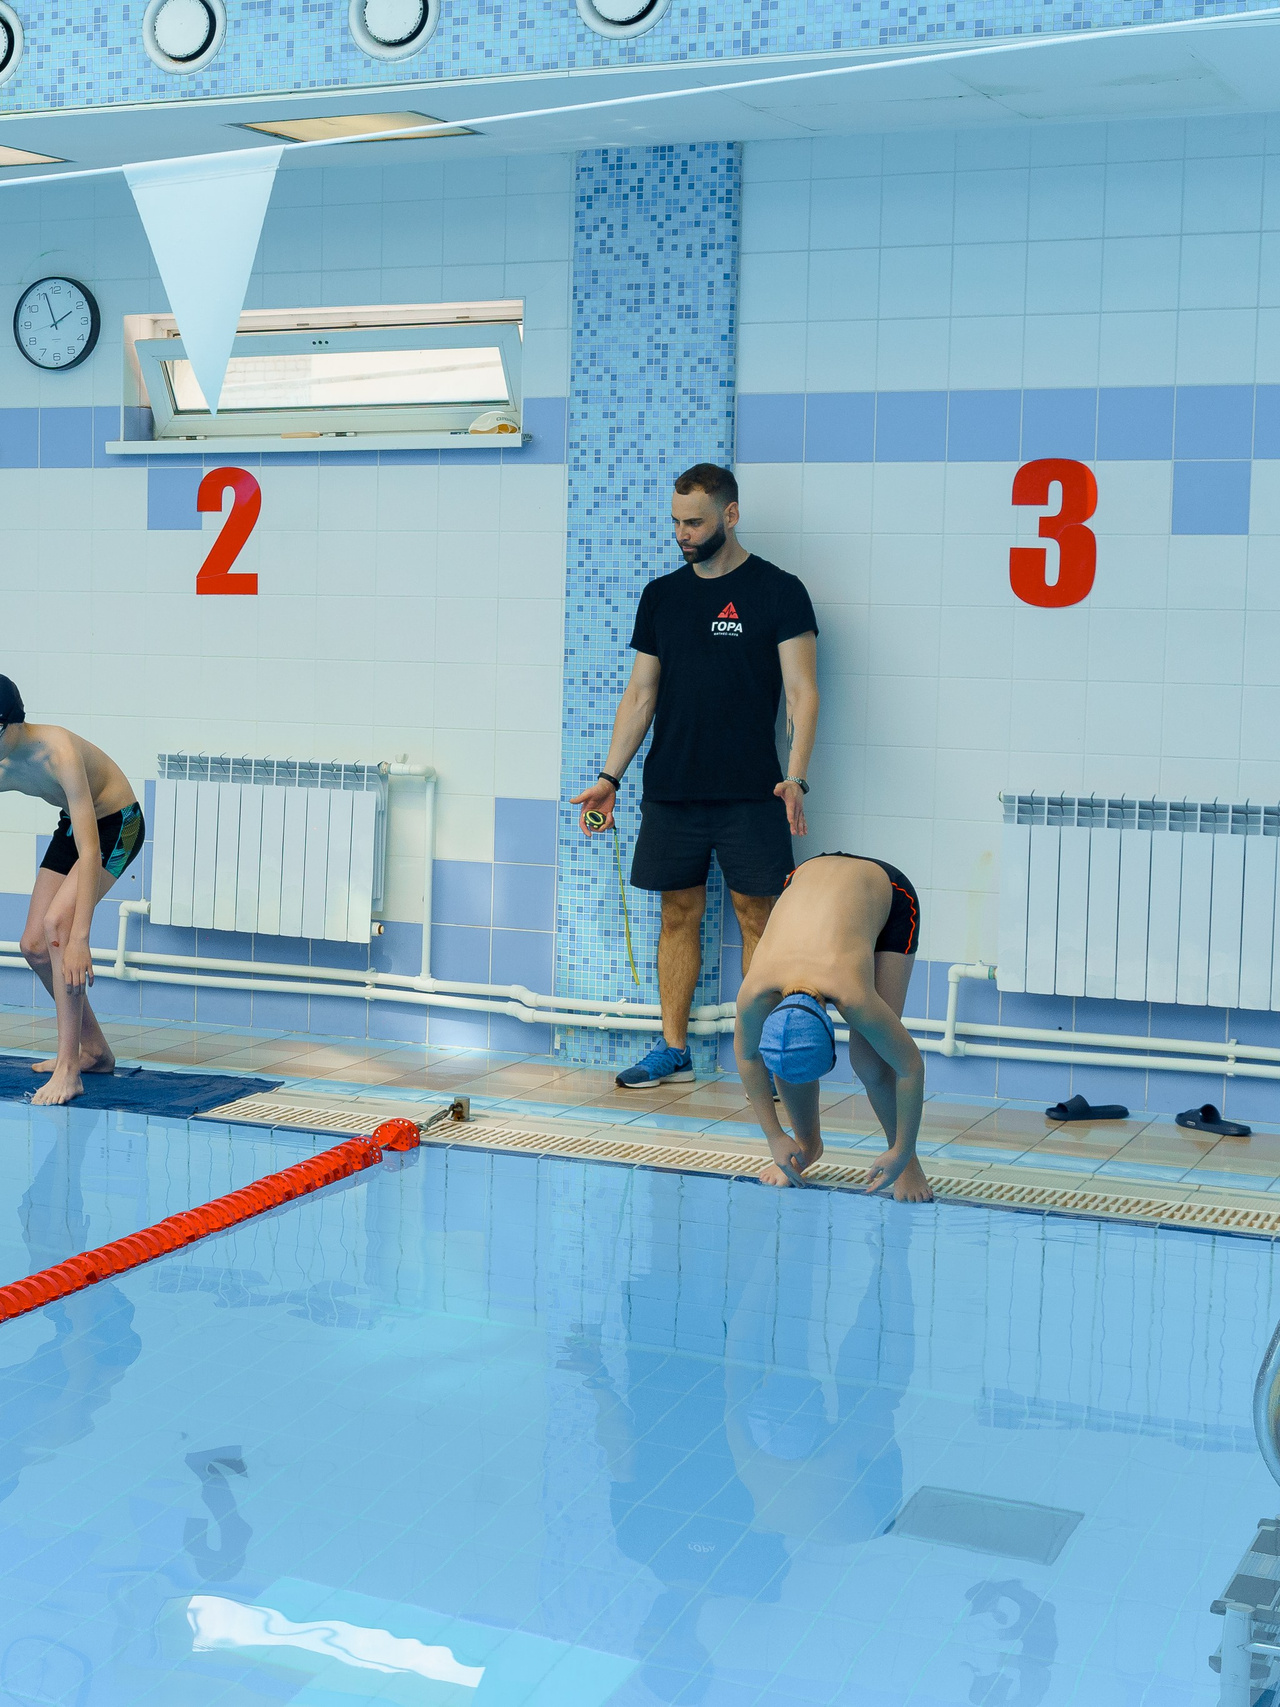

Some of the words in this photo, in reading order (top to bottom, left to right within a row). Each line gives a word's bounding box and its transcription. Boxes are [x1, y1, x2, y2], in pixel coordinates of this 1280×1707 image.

[49, 285, 62, 294] 12
[67, 290, 72, 298] 1
[27, 304, 39, 313] 10
[75, 301, 84, 309] 2
[24, 321, 32, 329] 9
[81, 317, 89, 325] 3
[29, 337, 37, 345] 8
[77, 334, 85, 342] 4
[39, 348, 47, 357] 7
[67, 346, 75, 354] 5
[53, 352, 61, 361] 6
[196, 466, 262, 595] 2
[1010, 458, 1098, 608] 3
[711, 621, 743, 632] ГОРА
